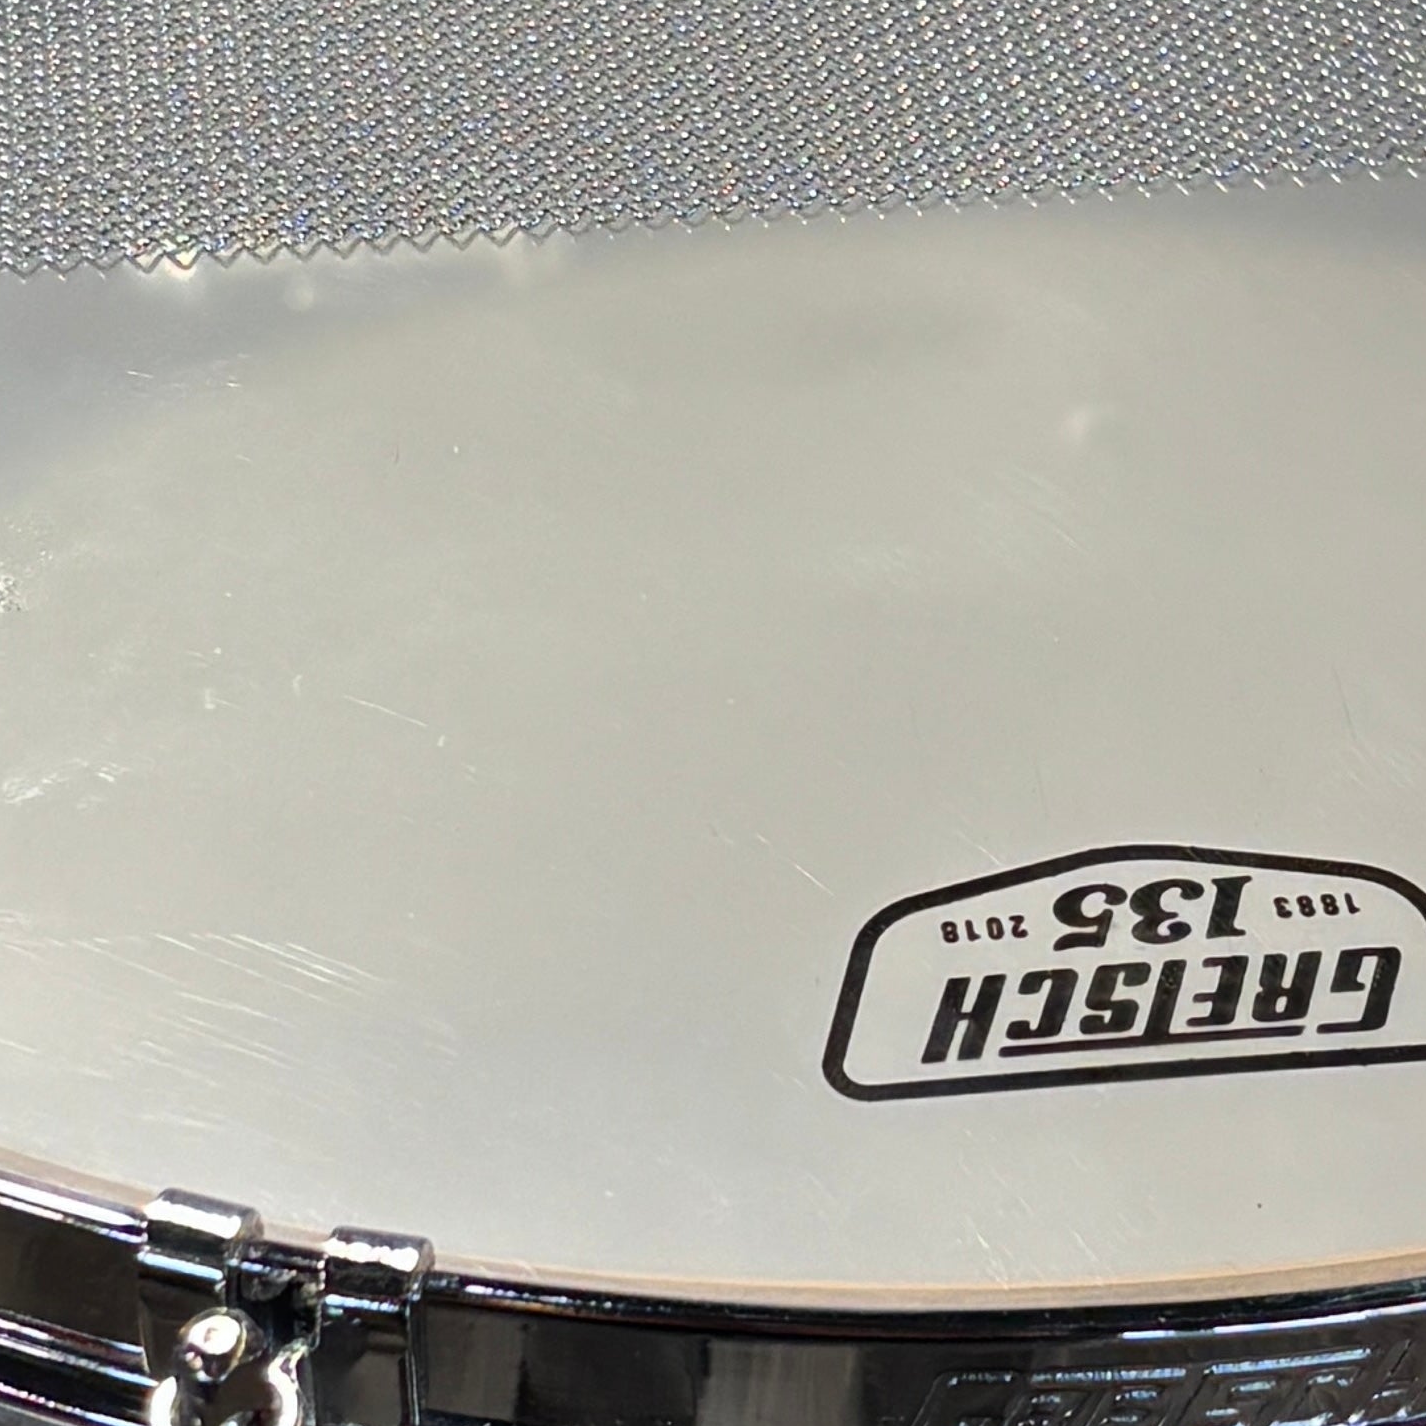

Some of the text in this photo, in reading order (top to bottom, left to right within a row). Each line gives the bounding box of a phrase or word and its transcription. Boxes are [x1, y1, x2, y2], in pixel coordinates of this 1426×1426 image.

[940, 875, 1361, 952] 1883 135 2018
[920, 946, 1402, 1064] GRETSCH
